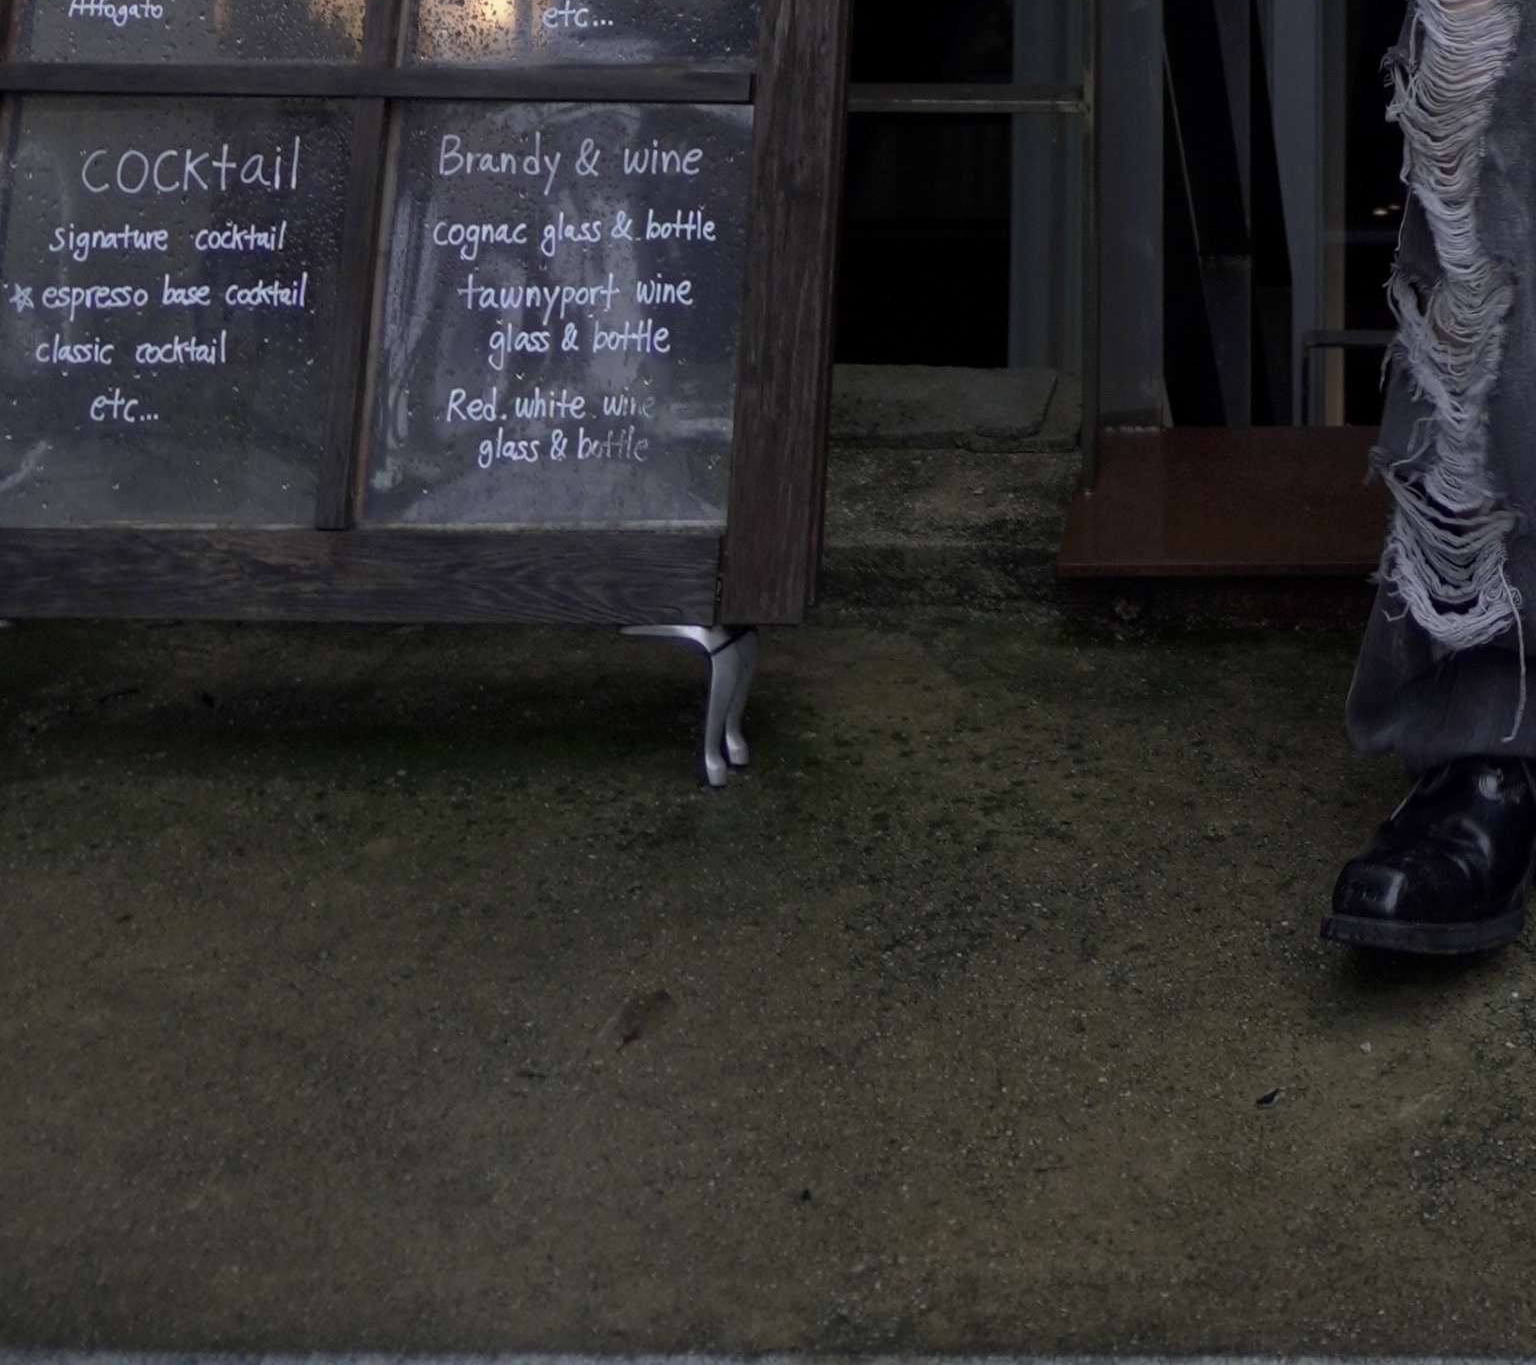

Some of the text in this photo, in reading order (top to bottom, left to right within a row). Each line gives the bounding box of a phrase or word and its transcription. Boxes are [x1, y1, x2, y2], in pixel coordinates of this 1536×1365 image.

[438, 130, 703, 197] Brandy & wine
[195, 220, 287, 252] cocktail
[433, 208, 716, 261] cognac glass & bottle
[41, 271, 309, 322] espresso base cocktail
[635, 273, 694, 307] wine
[35, 329, 227, 366] classic cocktail
[487, 318, 671, 371] glass & bottle
[514, 387, 586, 419] white
[478, 427, 541, 469] glass
[550, 428, 568, 460] &
